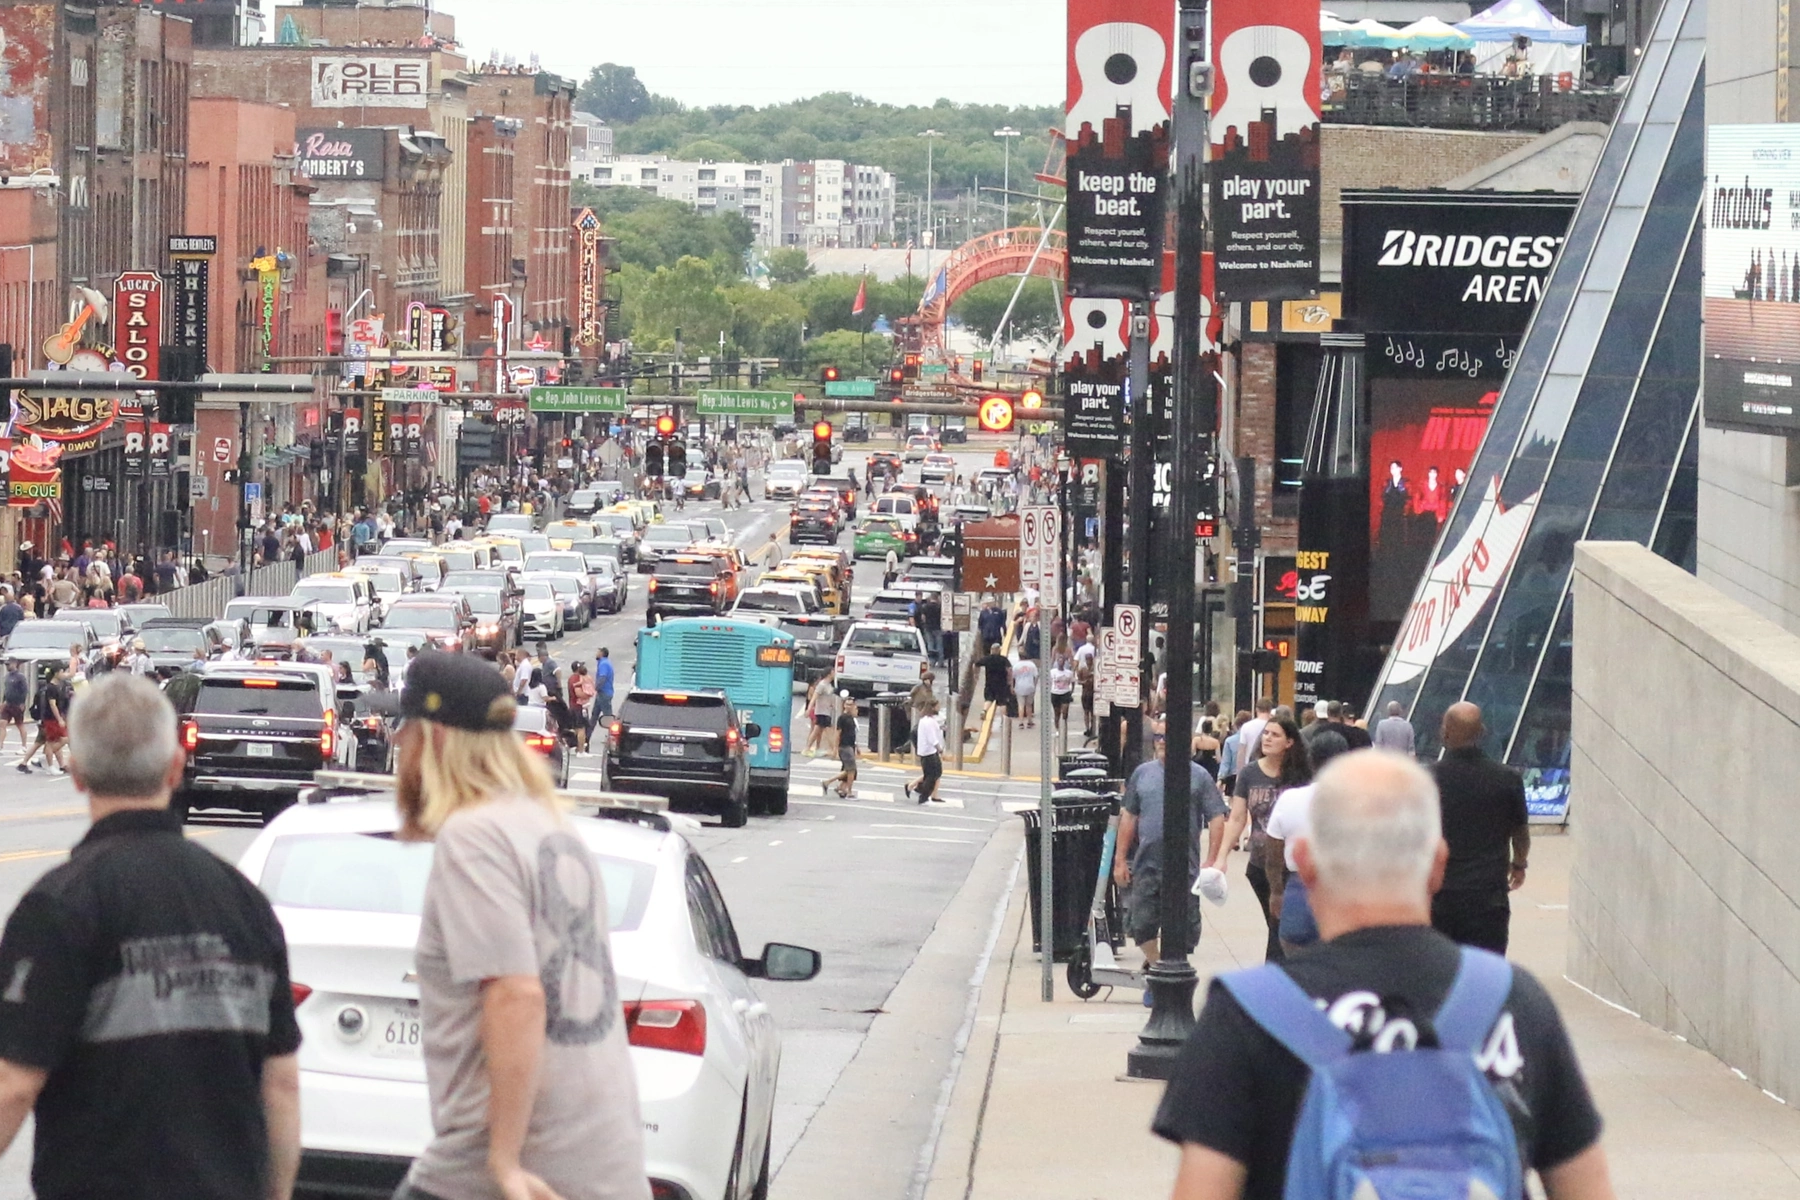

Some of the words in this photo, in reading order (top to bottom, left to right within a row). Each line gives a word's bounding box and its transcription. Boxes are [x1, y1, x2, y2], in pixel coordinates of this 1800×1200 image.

[342, 63, 421, 79] OLE
[342, 79, 421, 95] RED
[306, 133, 353, 158] Rosa
[1079, 171, 1124, 196] keep
[1129, 172, 1156, 193] the
[1223, 175, 1261, 200] play
[1265, 179, 1310, 200] your
[1095, 194, 1141, 216] beat.
[1712, 175, 1773, 230] incubus
[1242, 200, 1291, 223] part.
[1084, 227, 1116, 237] Respect
[1117, 228, 1146, 237] yourself,
[1231, 231, 1263, 240] Respect
[1265, 230, 1300, 240] yourself,
[1079, 239, 1107, 248] others,
[1136, 241, 1149, 249] city.
[1226, 243, 1254, 252] others,
[1288, 242, 1305, 252] city.
[1072, 256, 1109, 265] Welcome
[1110, 258, 1118, 266] to
[1120, 258, 1155, 267] Nashville!
[1219, 261, 1258, 269] Welcome
[1259, 261, 1268, 269] to
[1270, 260, 1312, 269] Nashville!
[119, 279, 159, 293] LUCKY
[394, 390, 436, 401] PARKING
[905, 390, 944, 398] Bridgestone
[1070, 381, 1093, 396] play
[1095, 383, 1120, 396] your
[545, 391, 560, 406] Rep.
[562, 392, 578, 404] John
[580, 392, 601, 405] Lewis
[616, 394, 621, 405] N
[702, 394, 717, 409] Rep.
[718, 394, 735, 407] John
[737, 395, 758, 408] Lewis
[772, 397, 777, 410] S
[1082, 397, 1110, 410] part.
[18, 388, 113, 426] STAGE
[967, 548, 979, 557] The
[985, 549, 1017, 558] District
[1441, 538, 1490, 628] INFO
[1058, 824, 1083, 832] Recycle
